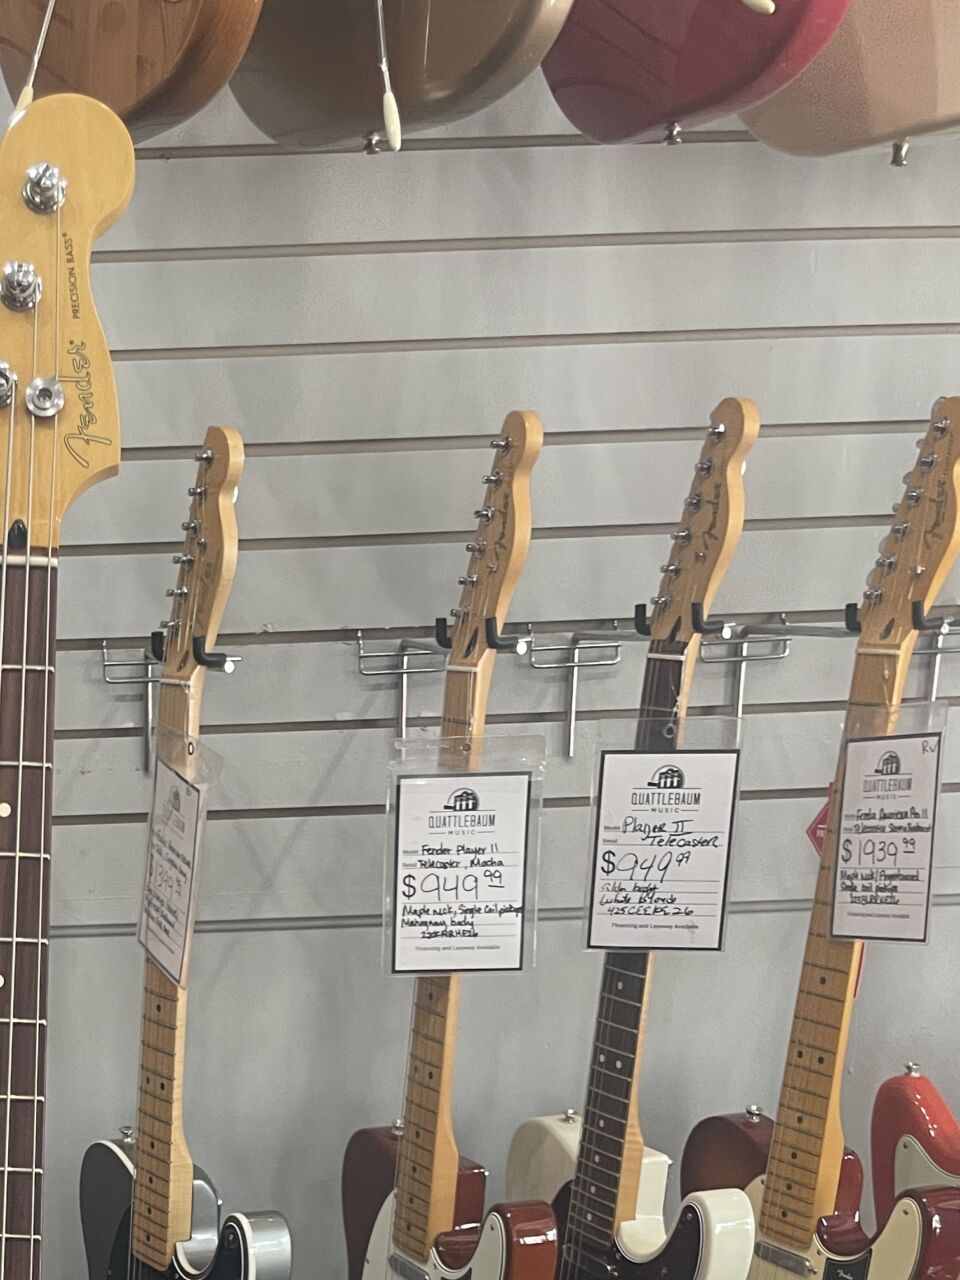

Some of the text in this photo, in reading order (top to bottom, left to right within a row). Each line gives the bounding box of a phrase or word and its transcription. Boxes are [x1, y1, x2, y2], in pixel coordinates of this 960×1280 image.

[70, 267, 80, 319] PRECISION
[58, 340, 112, 468] Fender
[632, 793, 700, 805] QUATTLEBAUM
[428, 815, 495, 829] QUATTLEBAUM
[422, 844, 452, 856] Fender
[451, 917, 474, 929] body
